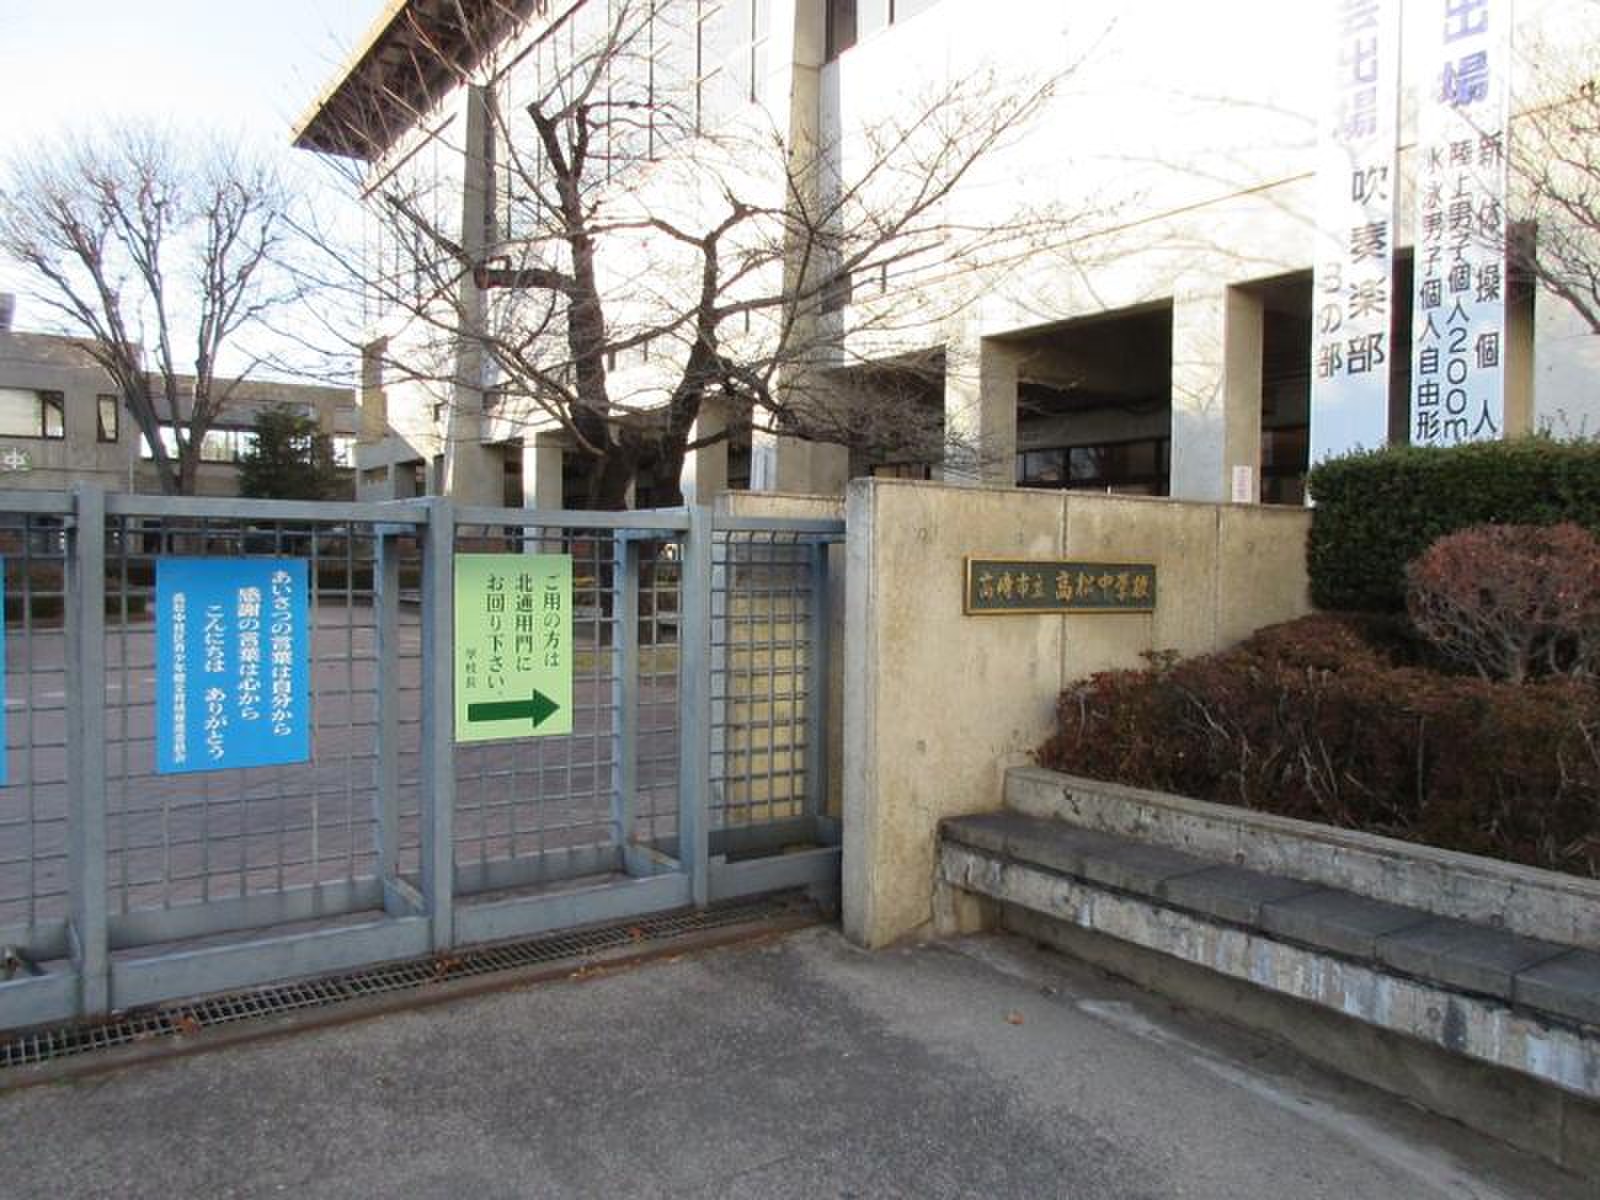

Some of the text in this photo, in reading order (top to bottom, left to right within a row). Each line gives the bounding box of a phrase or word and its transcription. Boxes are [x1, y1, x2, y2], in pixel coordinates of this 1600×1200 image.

[204, 604, 228, 760] こんにちは ありがとう
[237, 586, 262, 720] 感謝の言葉は心から
[271, 570, 292, 736] あいさつの言葉は自分から
[514, 572, 534, 672] 北通用門に
[543, 575, 561, 668] ご用の方は
